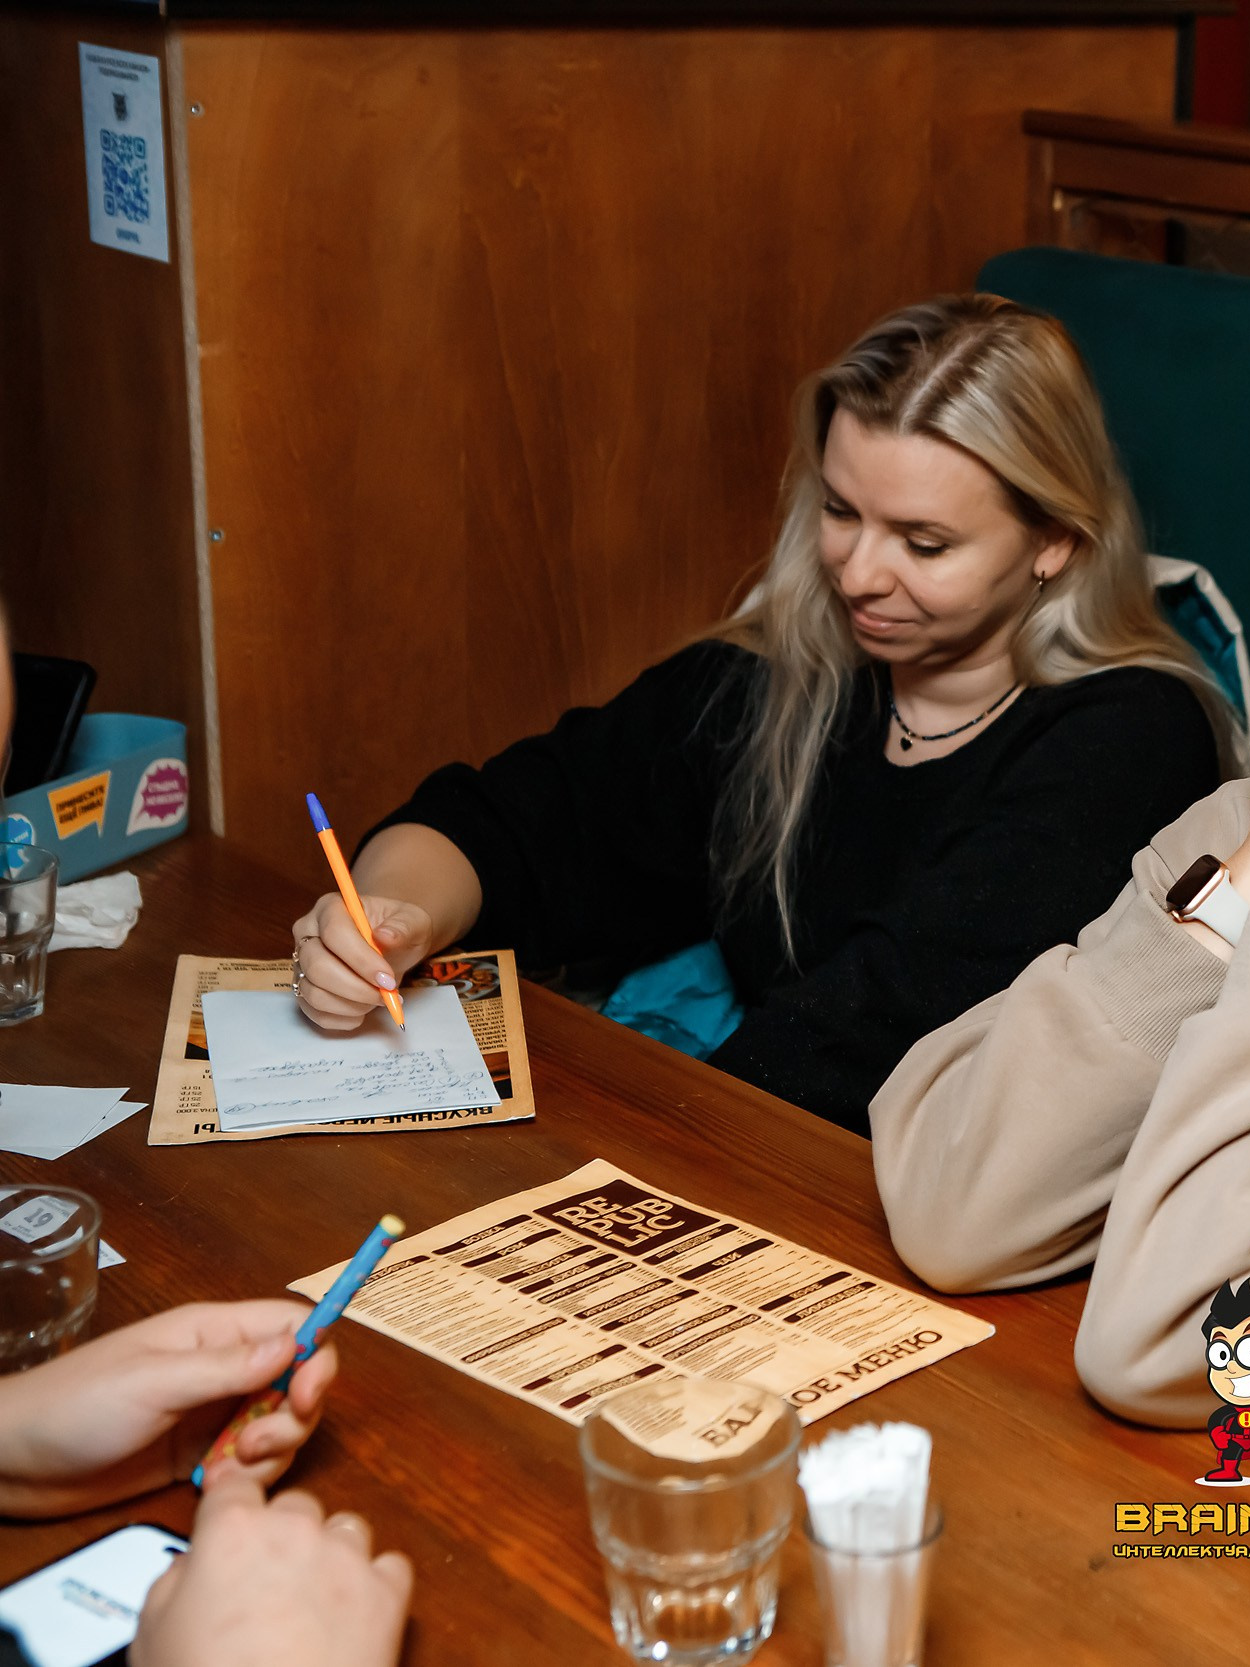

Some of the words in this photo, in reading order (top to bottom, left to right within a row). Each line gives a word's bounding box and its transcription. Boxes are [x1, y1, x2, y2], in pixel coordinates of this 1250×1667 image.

[552, 1196, 622, 1225] RE
[579, 1198, 674, 1237] PUB
[459, 1225, 505, 1245] ВОДКА
[602, 1214, 686, 1248] LIC
[495, 1241, 529, 1255] РОМ
[358, 1258, 416, 1284] ТЕЙЛИ
[836, 1330, 944, 1382] МЕНЮ
